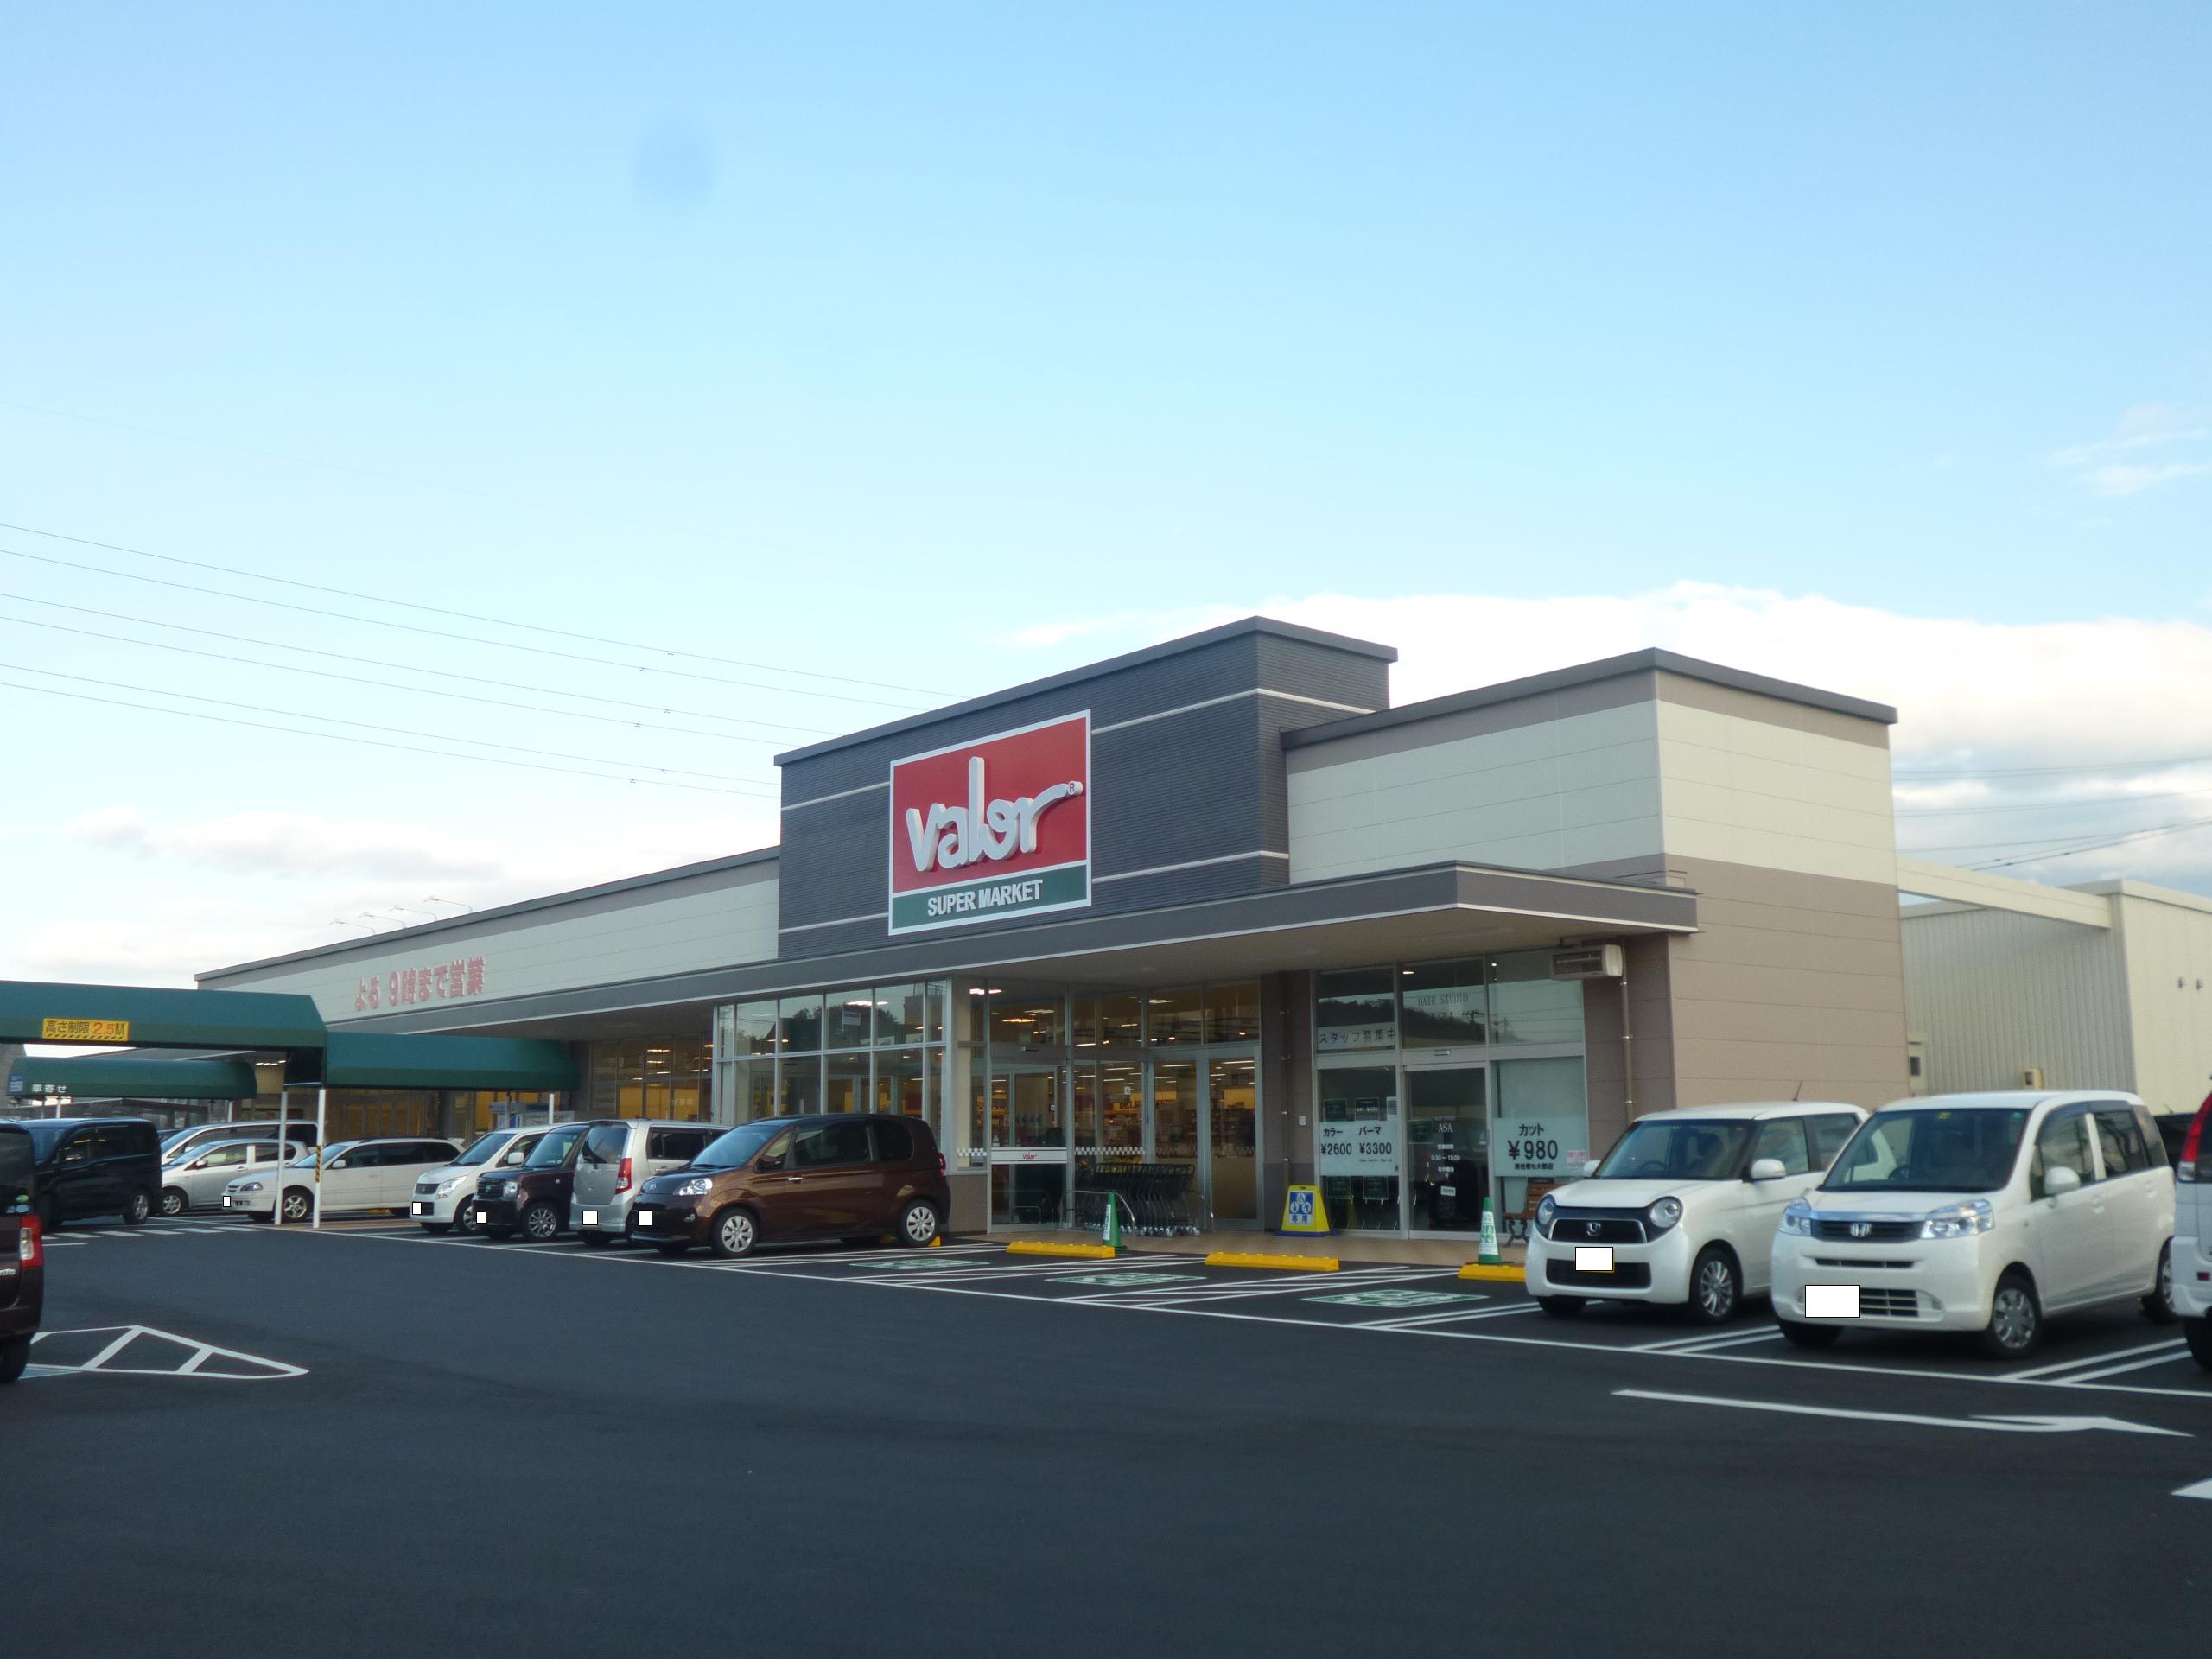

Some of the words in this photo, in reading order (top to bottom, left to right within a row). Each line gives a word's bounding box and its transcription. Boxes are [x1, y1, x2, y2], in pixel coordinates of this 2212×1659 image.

[927, 891, 976, 917] SUPER
[978, 880, 1043, 908] MARKET
[1418, 995, 1436, 1007] HAIR
[46, 1020, 90, 1035] 高さ制限
[92, 1022, 125, 1035] 2.5M
[1323, 1128, 1343, 1137] カラー
[1519, 1123, 1545, 1136] カット
[1320, 1142, 1352, 1155] ¥2600
[1359, 1141, 1392, 1155] ¥3300
[1508, 1139, 1559, 1160] ¥980
